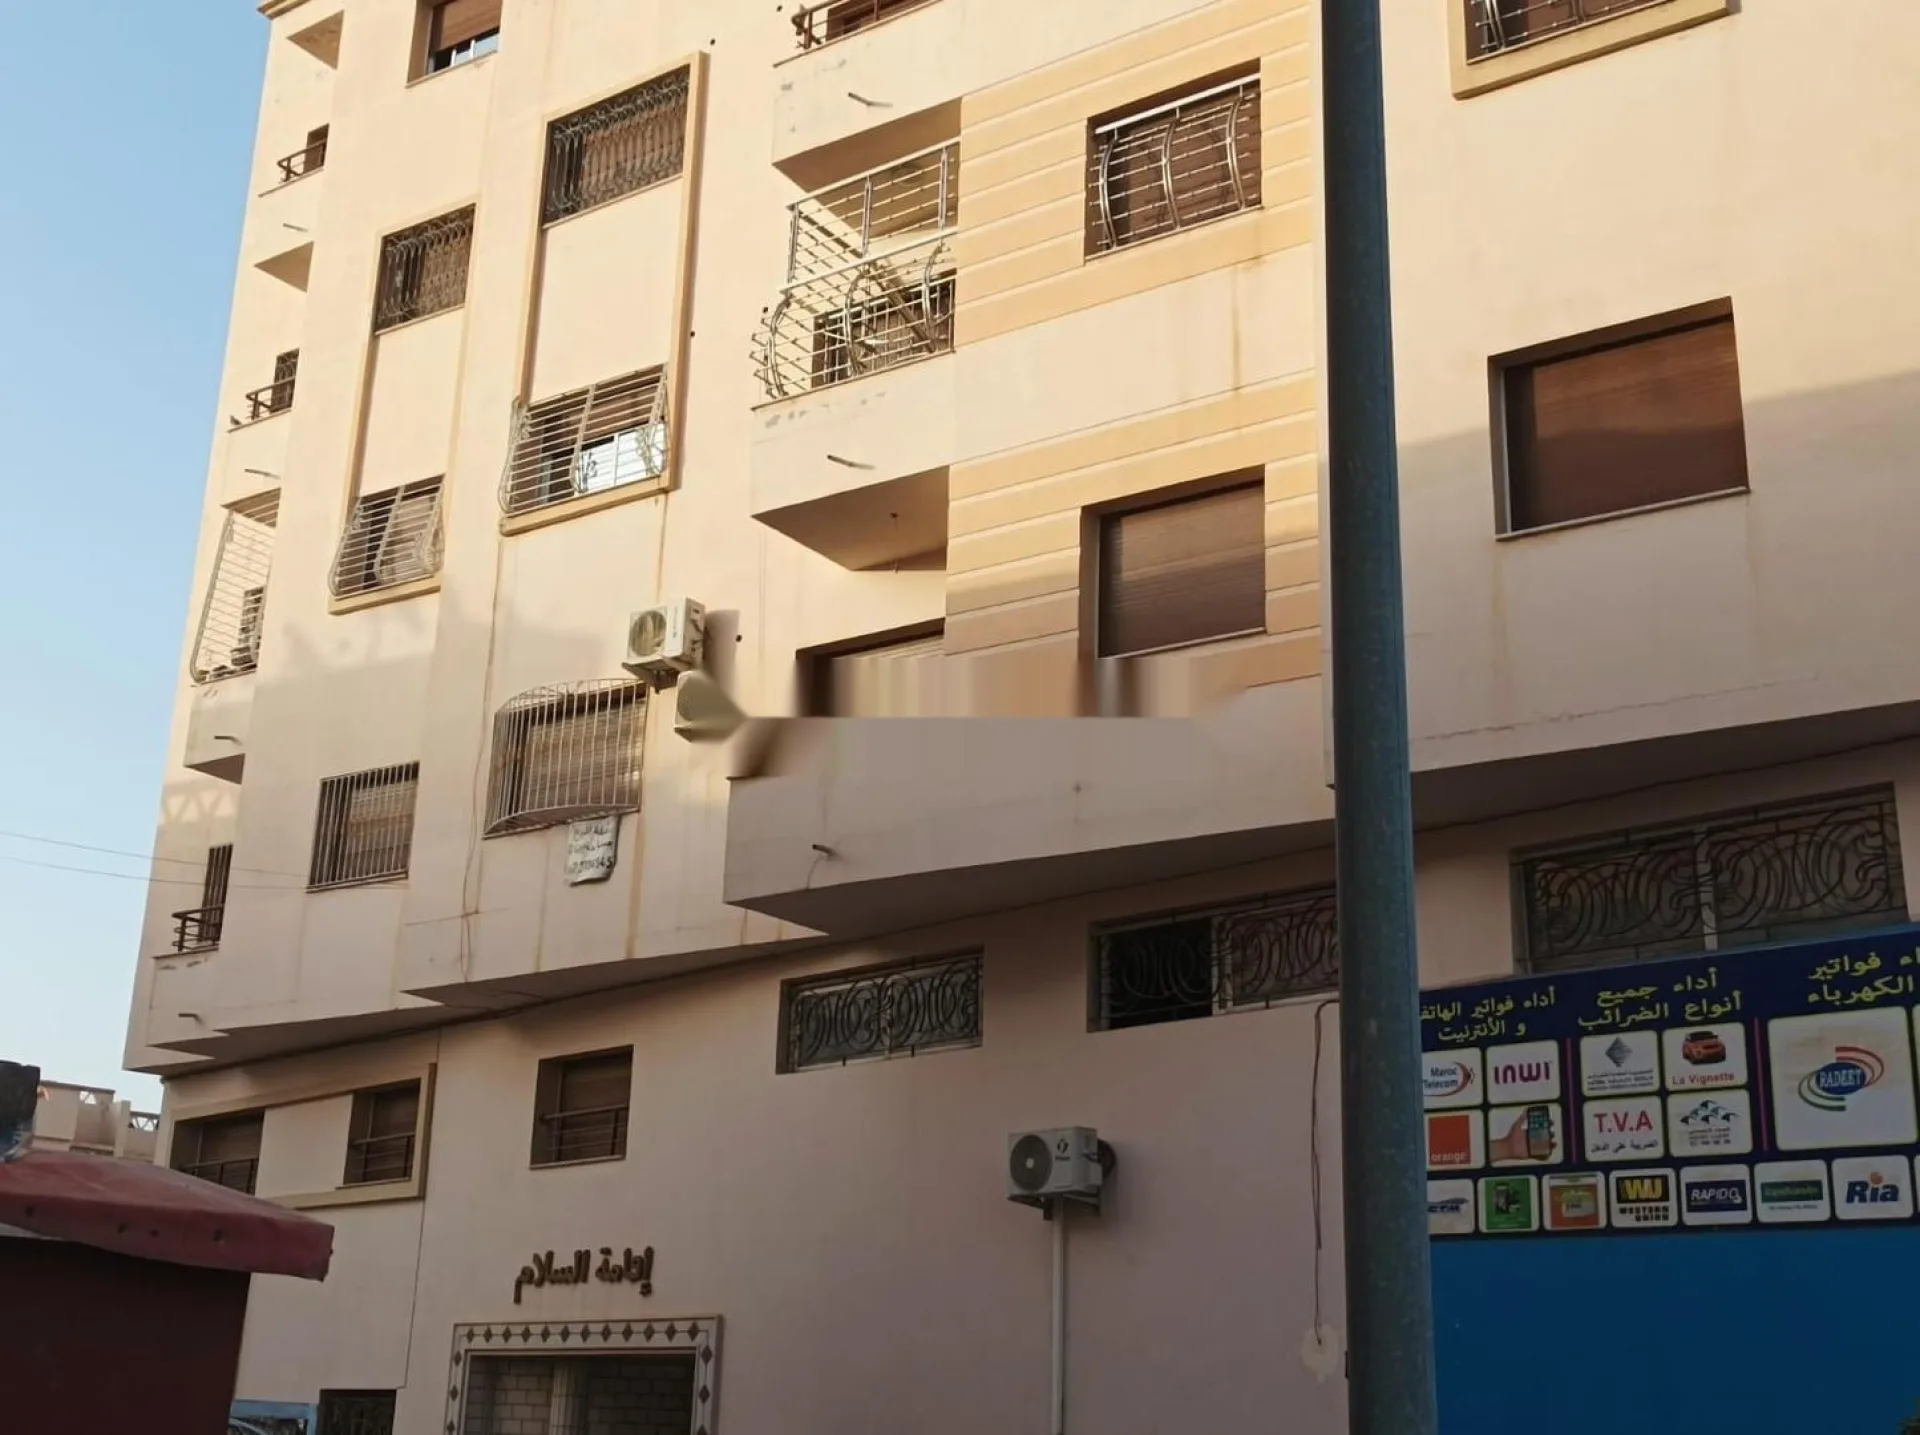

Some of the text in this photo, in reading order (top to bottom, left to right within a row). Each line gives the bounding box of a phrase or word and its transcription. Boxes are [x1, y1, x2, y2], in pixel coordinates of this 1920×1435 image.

[1808, 951, 1882, 980] فواتير
[1523, 985, 1556, 1009] أداء
[1597, 967, 1717, 1007] أداء جميع
[1807, 974, 1914, 1006] الكهرباء
[1471, 994, 1515, 1019] فواتير
[1577, 990, 1742, 1030] أنواع الضرائب
[1515, 1022, 1527, 1036] و
[1430, 1066, 1457, 1077] Maroc
[1672, 1071, 1735, 1085] La Vignette
[1593, 1110, 1654, 1133] T.V.A
[1431, 1151, 1467, 1164] orange
[1846, 1171, 1899, 1204] Ria
[1619, 1205, 1669, 1215] WESTERN
[1635, 1213, 1669, 1222] UNION
[513, 1246, 654, 1305] إقامة السلام
